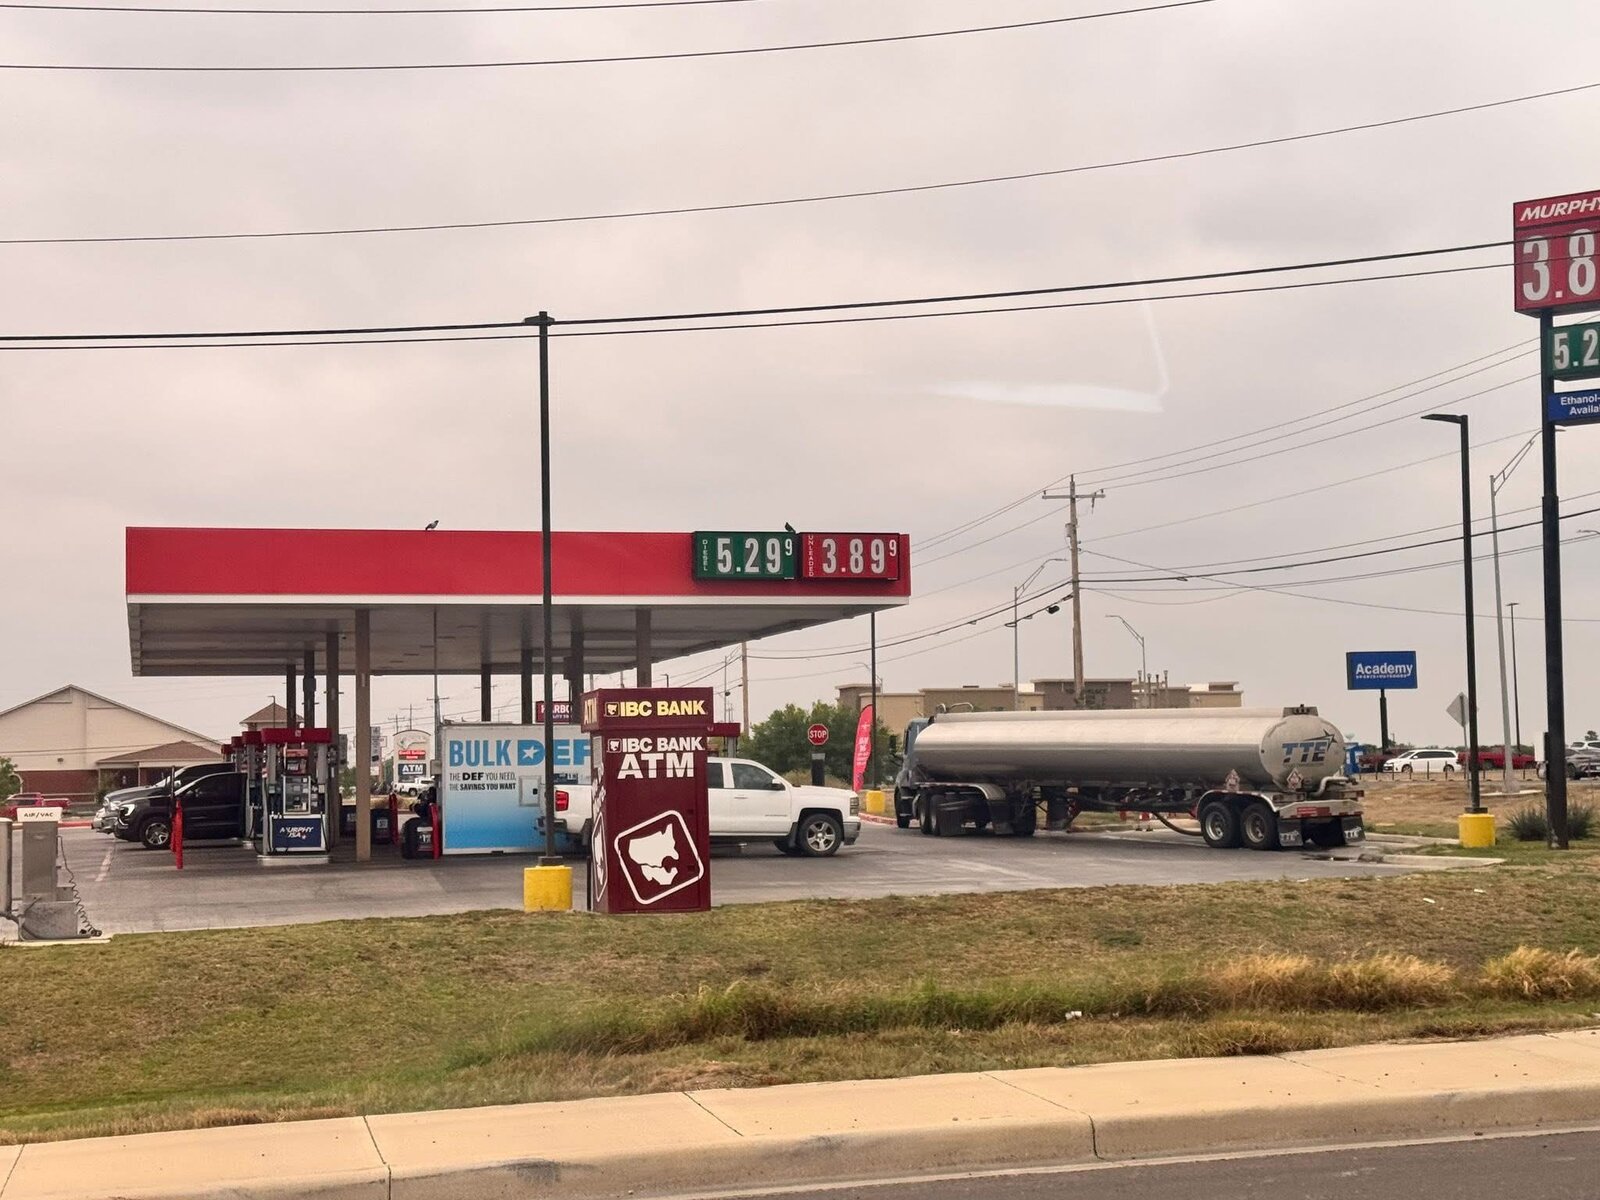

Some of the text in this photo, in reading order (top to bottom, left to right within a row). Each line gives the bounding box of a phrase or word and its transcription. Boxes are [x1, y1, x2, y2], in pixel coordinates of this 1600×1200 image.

[1569, 404, 1600, 416] Availa
[1355, 662, 1413, 676] Academy
[620, 700, 706, 717] IBC BANK
[809, 730, 826, 739] STOP
[622, 737, 705, 752] IBC BANK
[449, 739, 591, 767] BULK DEF
[1281, 740, 1329, 764] TTE
[401, 764, 423, 772] ATM
[617, 752, 695, 779] ATM
[449, 772, 460, 781] THE
[462, 772, 484, 781] DEF
[485, 772, 499, 781] YOU
[449, 782, 516, 791] THE SAVINGS YOU WANT
